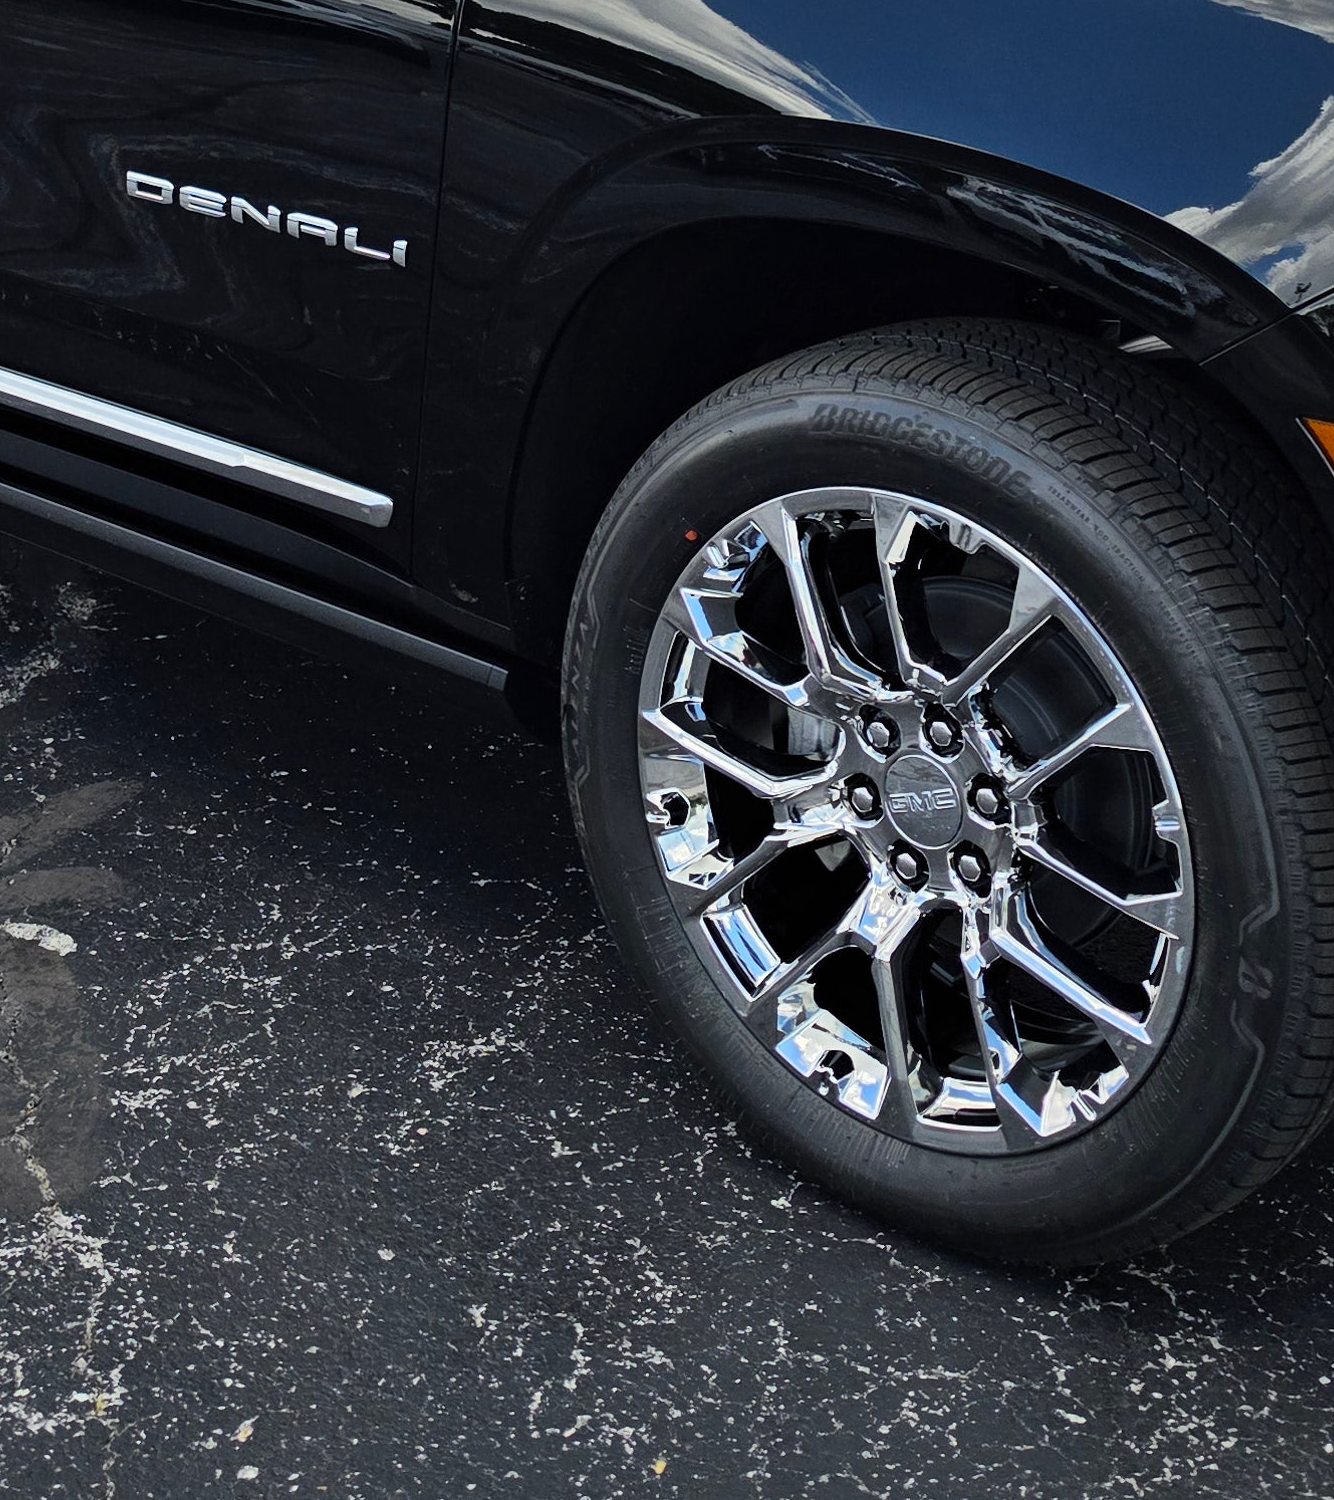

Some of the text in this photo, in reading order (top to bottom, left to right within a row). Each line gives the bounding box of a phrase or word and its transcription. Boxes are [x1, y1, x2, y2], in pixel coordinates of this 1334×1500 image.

[126, 170, 408, 268] DENALI
[809, 403, 1033, 498] BRIDGESTONE
[889, 788, 956, 813] GMC
